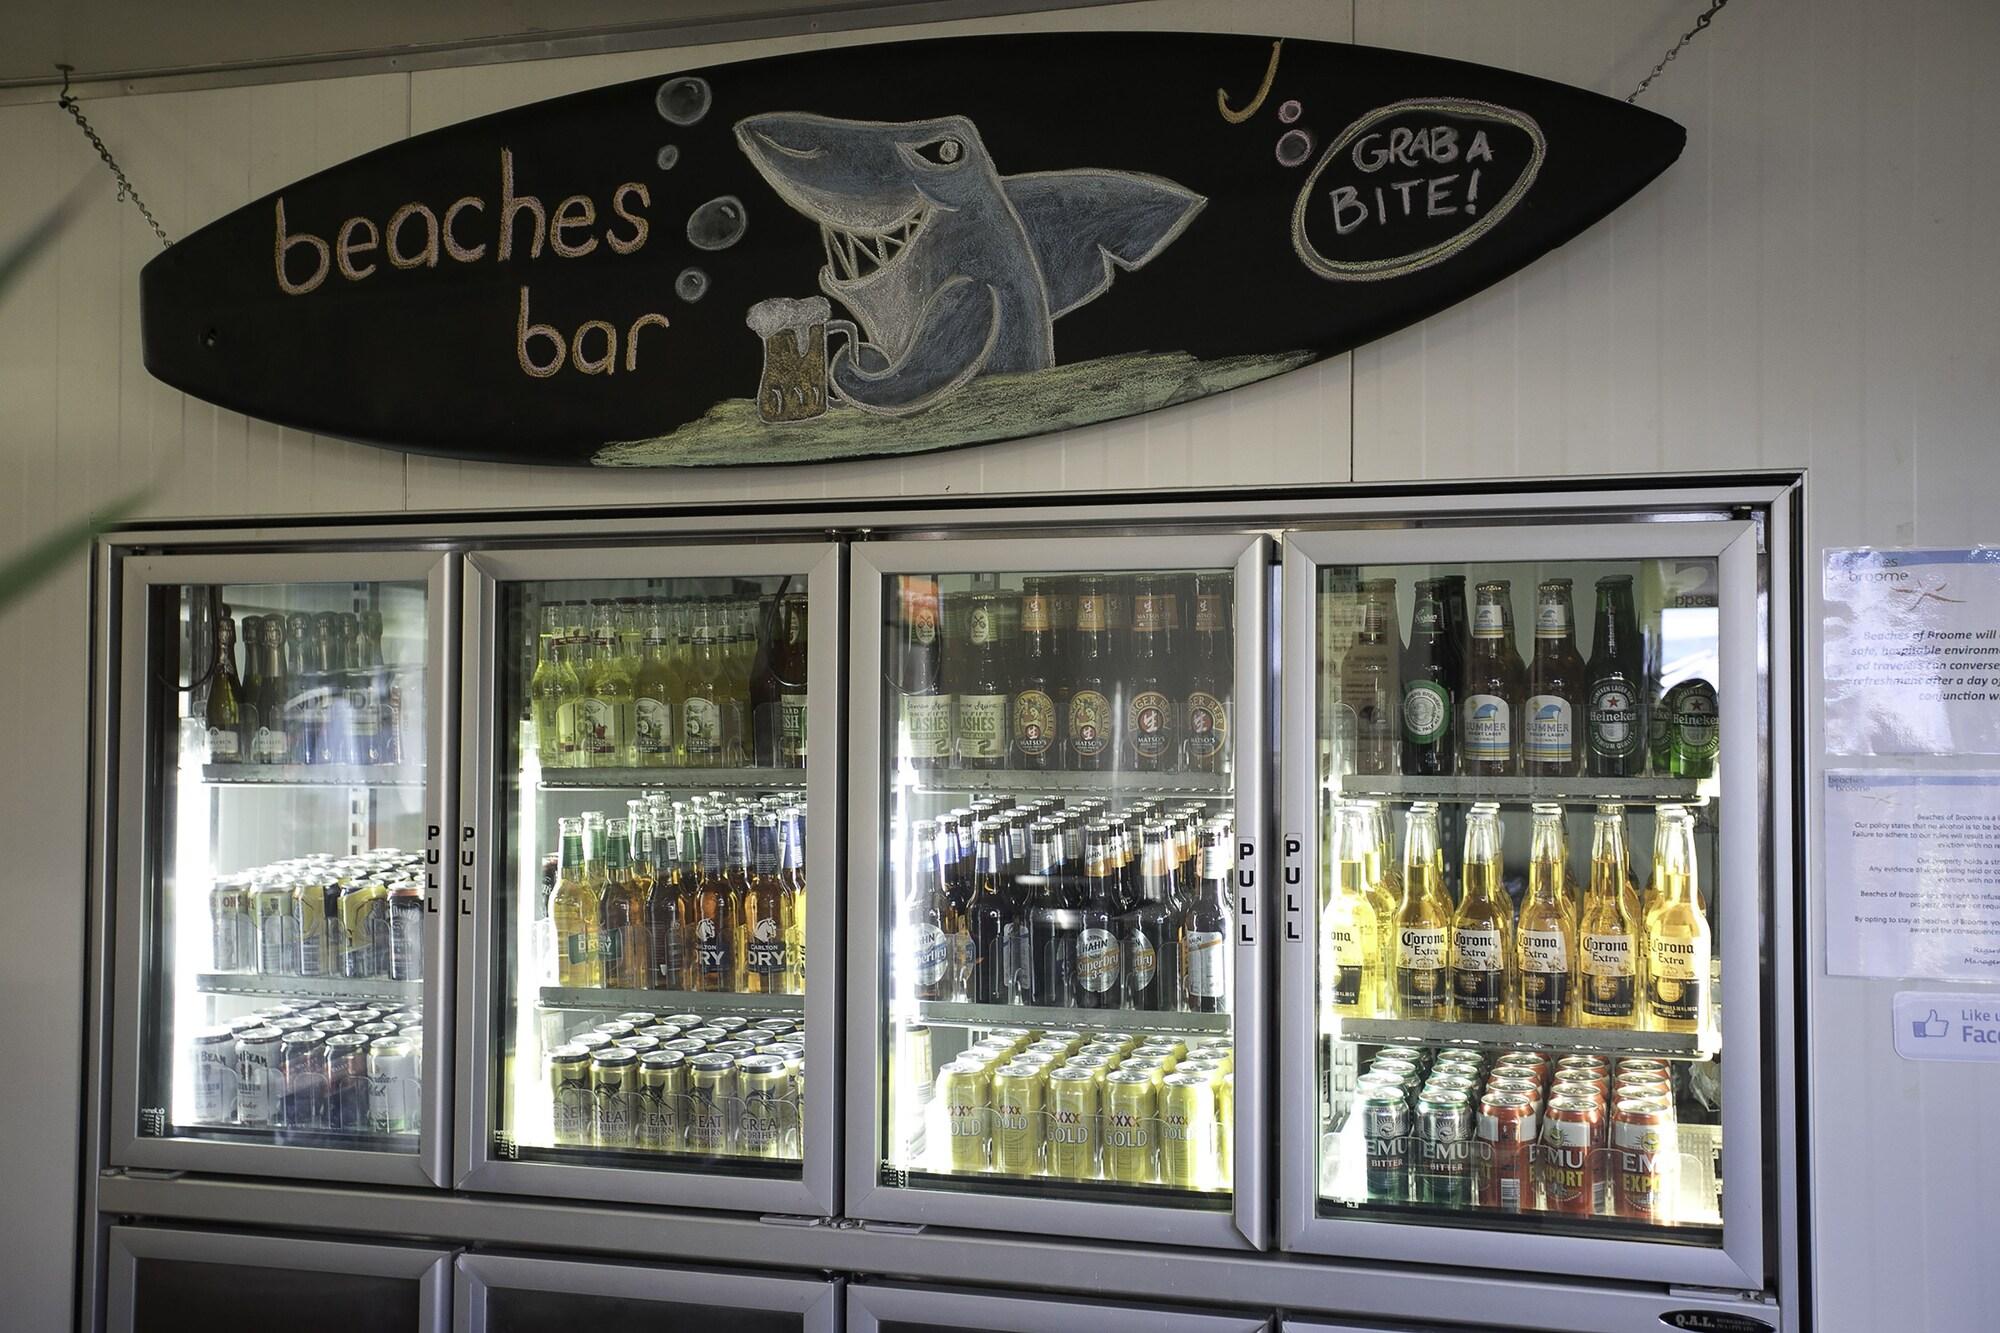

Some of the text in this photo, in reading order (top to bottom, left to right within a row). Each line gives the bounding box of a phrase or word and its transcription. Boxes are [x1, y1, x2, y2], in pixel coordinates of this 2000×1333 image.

[1352, 125, 1494, 173] GRAB A
[1328, 168, 1481, 235] BITE!
[275, 147, 651, 296] beaches
[517, 284, 669, 378] bar
[1912, 630, 1925, 642] of
[1927, 630, 1972, 640] Broome
[1976, 629, 1997, 640] will
[1966, 675, 1988, 688] day
[1206, 701, 1225, 728] BEER
[910, 716, 949, 731] LASHES
[1526, 722, 1569, 733] SUMMER
[1869, 822, 1890, 830] policy
[1852, 830, 1874, 838] Failure
[1885, 831, 1909, 839] adhere
[427, 825, 440, 913] PULL
[462, 827, 475, 915] PULL
[1239, 843, 1254, 942] PULL
[1285, 840, 1301, 940] PULL
[1864, 916, 1888, 924] opting
[1083, 939, 1108, 953] HAHN
[1518, 932, 1558, 950] Corona
[1582, 936, 1629, 952] Corona
[1652, 939, 1695, 954] Corona
[748, 950, 786, 966] DRY
[1414, 945, 1439, 956] Extra
[1460, 945, 1487, 958] Extra
[1524, 947, 1548, 960] Extra
[1592, 951, 1620, 963] Extra
[1658, 953, 1685, 965] Extra
[1962, 1008, 1990, 1021] Like
[1962, 1025, 2000, 1043] Fac
[201, 1050, 226, 1066] BEAM
[741, 1117, 778, 1131] GREA
[951, 1119, 981, 1136] OLD
[1109, 1115, 1141, 1128] XXXX
[1047, 1123, 1088, 1144] GOLD
[1104, 1128, 1148, 1147] GOLD
[1367, 1139, 1408, 1156] EMU
[1423, 1140, 1469, 1160] EMU
[1371, 1158, 1403, 1168] BITTER
[1430, 1162, 1464, 1172] BITTER
[1622, 1152, 1657, 1173] EM
[1529, 1165, 1585, 1187] EPORT
[1675, 1314, 1715, 1328] Q.A.L.
